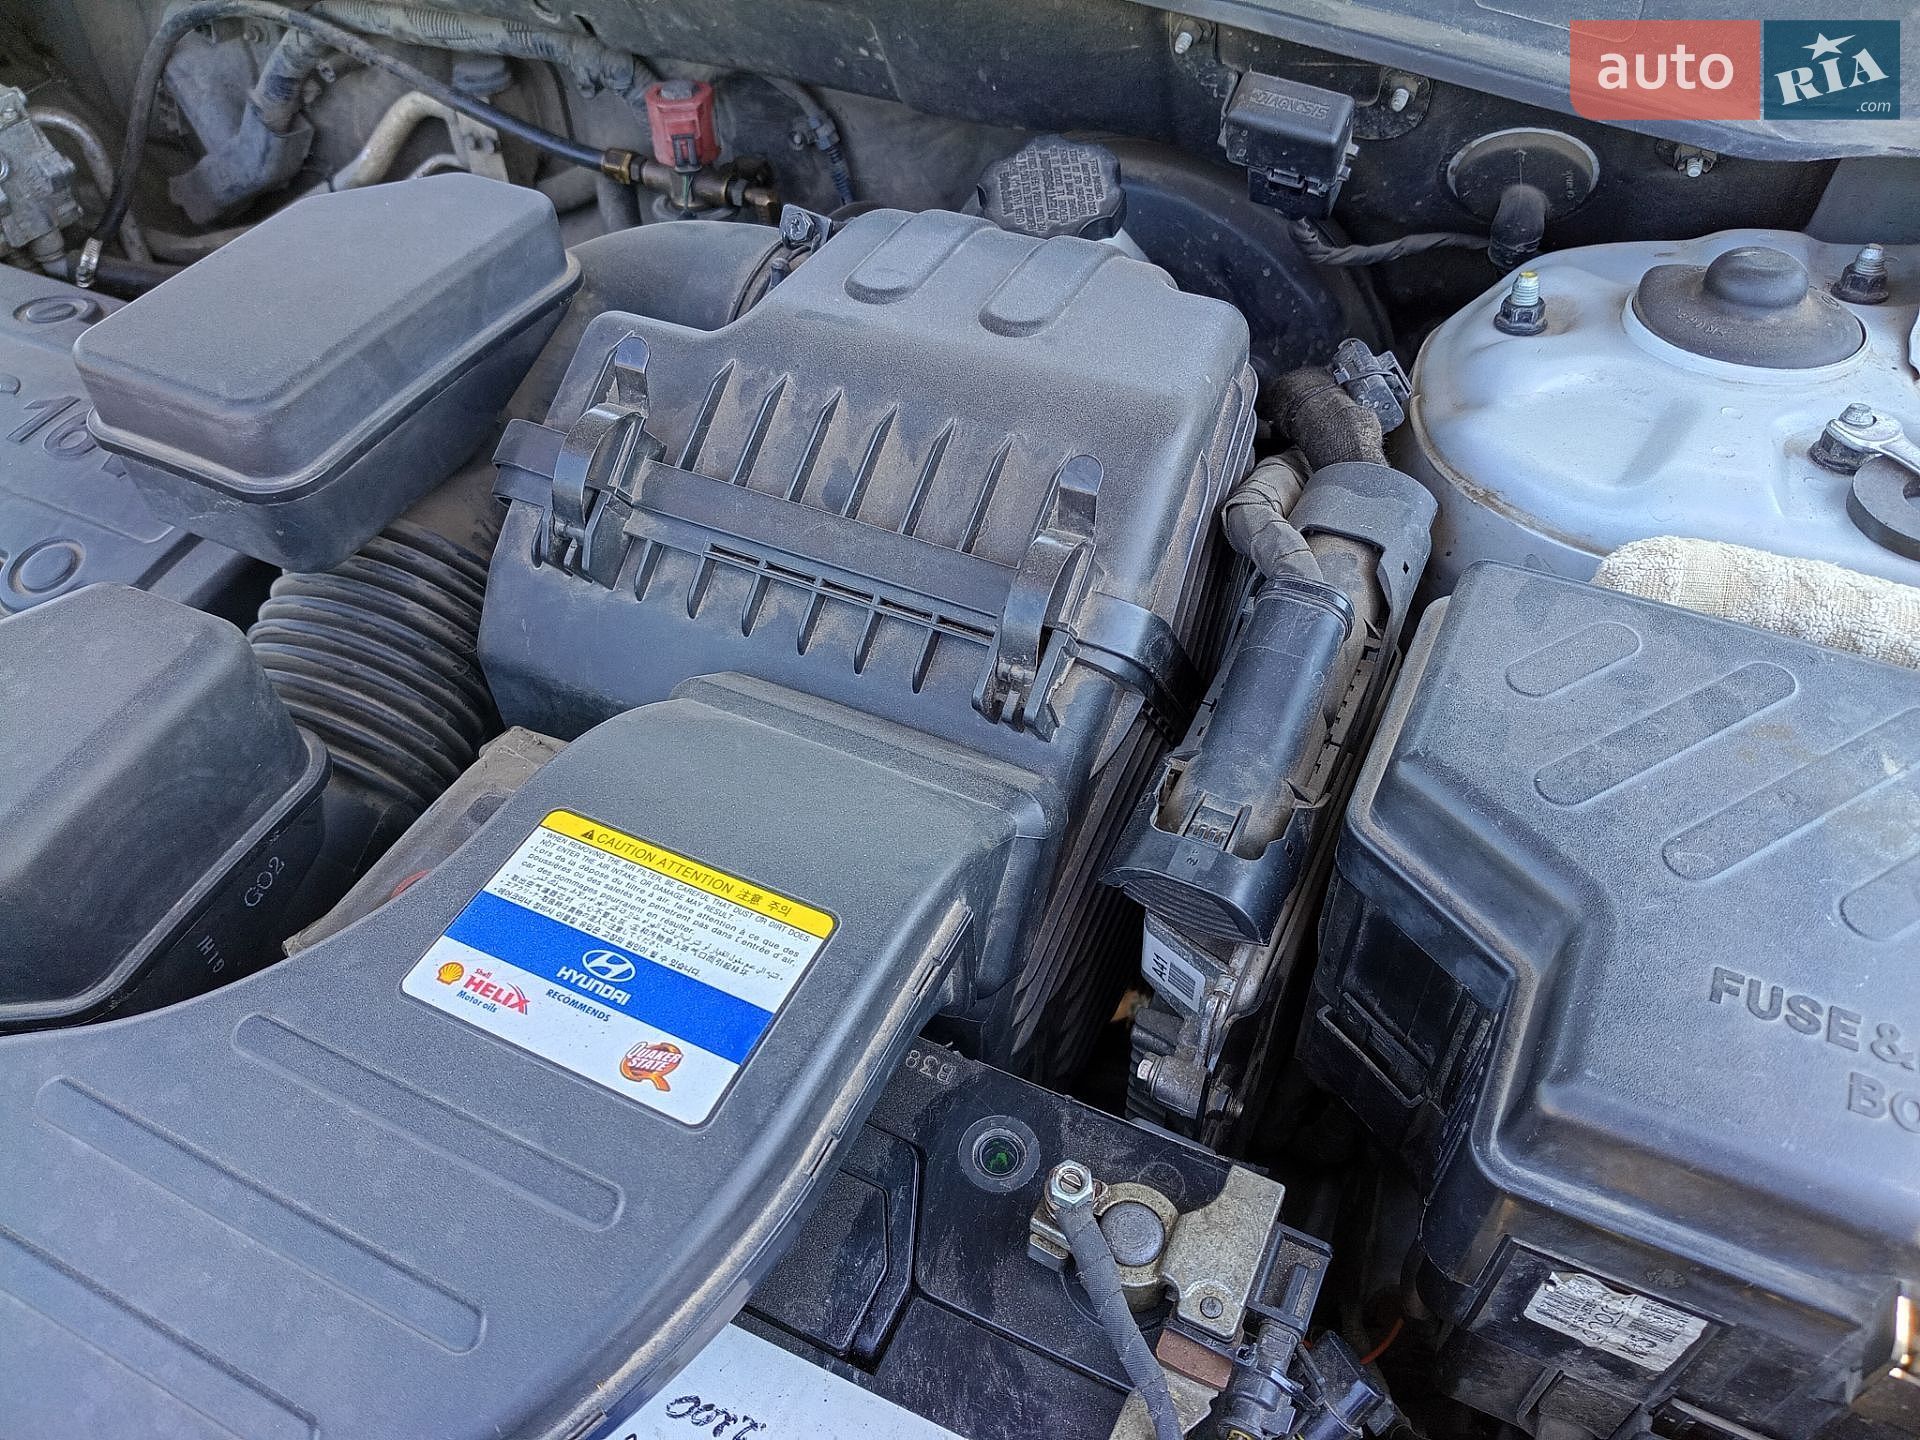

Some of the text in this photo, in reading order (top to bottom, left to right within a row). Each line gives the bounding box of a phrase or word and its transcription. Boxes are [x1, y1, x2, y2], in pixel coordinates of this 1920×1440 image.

[521, 860, 535, 869] car
[537, 866, 553, 876] des
[553, 873, 598, 896] dommages
[599, 892, 644, 914] pourraient
[646, 911, 658, 919] en
[534, 846, 553, 857] Lors
[555, 854, 566, 862] de
[611, 877, 623, 885] du
[625, 882, 645, 894] filtre
[674, 902, 694, 914] faire
[696, 911, 737, 932] attention
[748, 932, 759, 941] ce
[761, 938, 780, 951] que
[783, 946, 799, 957] des
[540, 839, 555, 849] NOT
[556, 846, 579, 858] ENTER
[581, 856, 596, 865] THE
[596, 862, 609, 870] AIR
[639, 879, 651, 887] OR
[652, 884, 683, 900] DAMAGE
[685, 897, 702, 908] MAY
[545, 832, 566, 844] WHEN
[568, 841, 605, 860] REMOVING
[607, 857, 621, 866] THE
[622, 863, 635, 871] AIR
[676, 885, 709, 901] CAREFUL
[712, 899, 730, 910] THAT
[733, 907, 753, 919] DUST
[755, 916, 766, 924] OR
[768, 921, 786, 932] DIRT
[788, 929, 809, 942] DOES
[595, 832, 656, 863] CAUTION
[657, 857, 734, 894] ATTENTION
[767, 900, 792, 918] 주의
[573, 870, 585, 878] ou
[586, 876, 602, 885] des
[635, 895, 646, 904] ne
[711, 926, 732, 939] dans
[457, 990, 497, 1013] Motor oils
[464, 975, 528, 1014] HELIX
[545, 988, 611, 1022] RECOMMENDS
[556, 965, 632, 1006] HYUNDAI
[1709, 966, 1915, 1071] FUSE &
[626, 1041, 683, 1065] QUAKER
[628, 1056, 669, 1073] STATE
